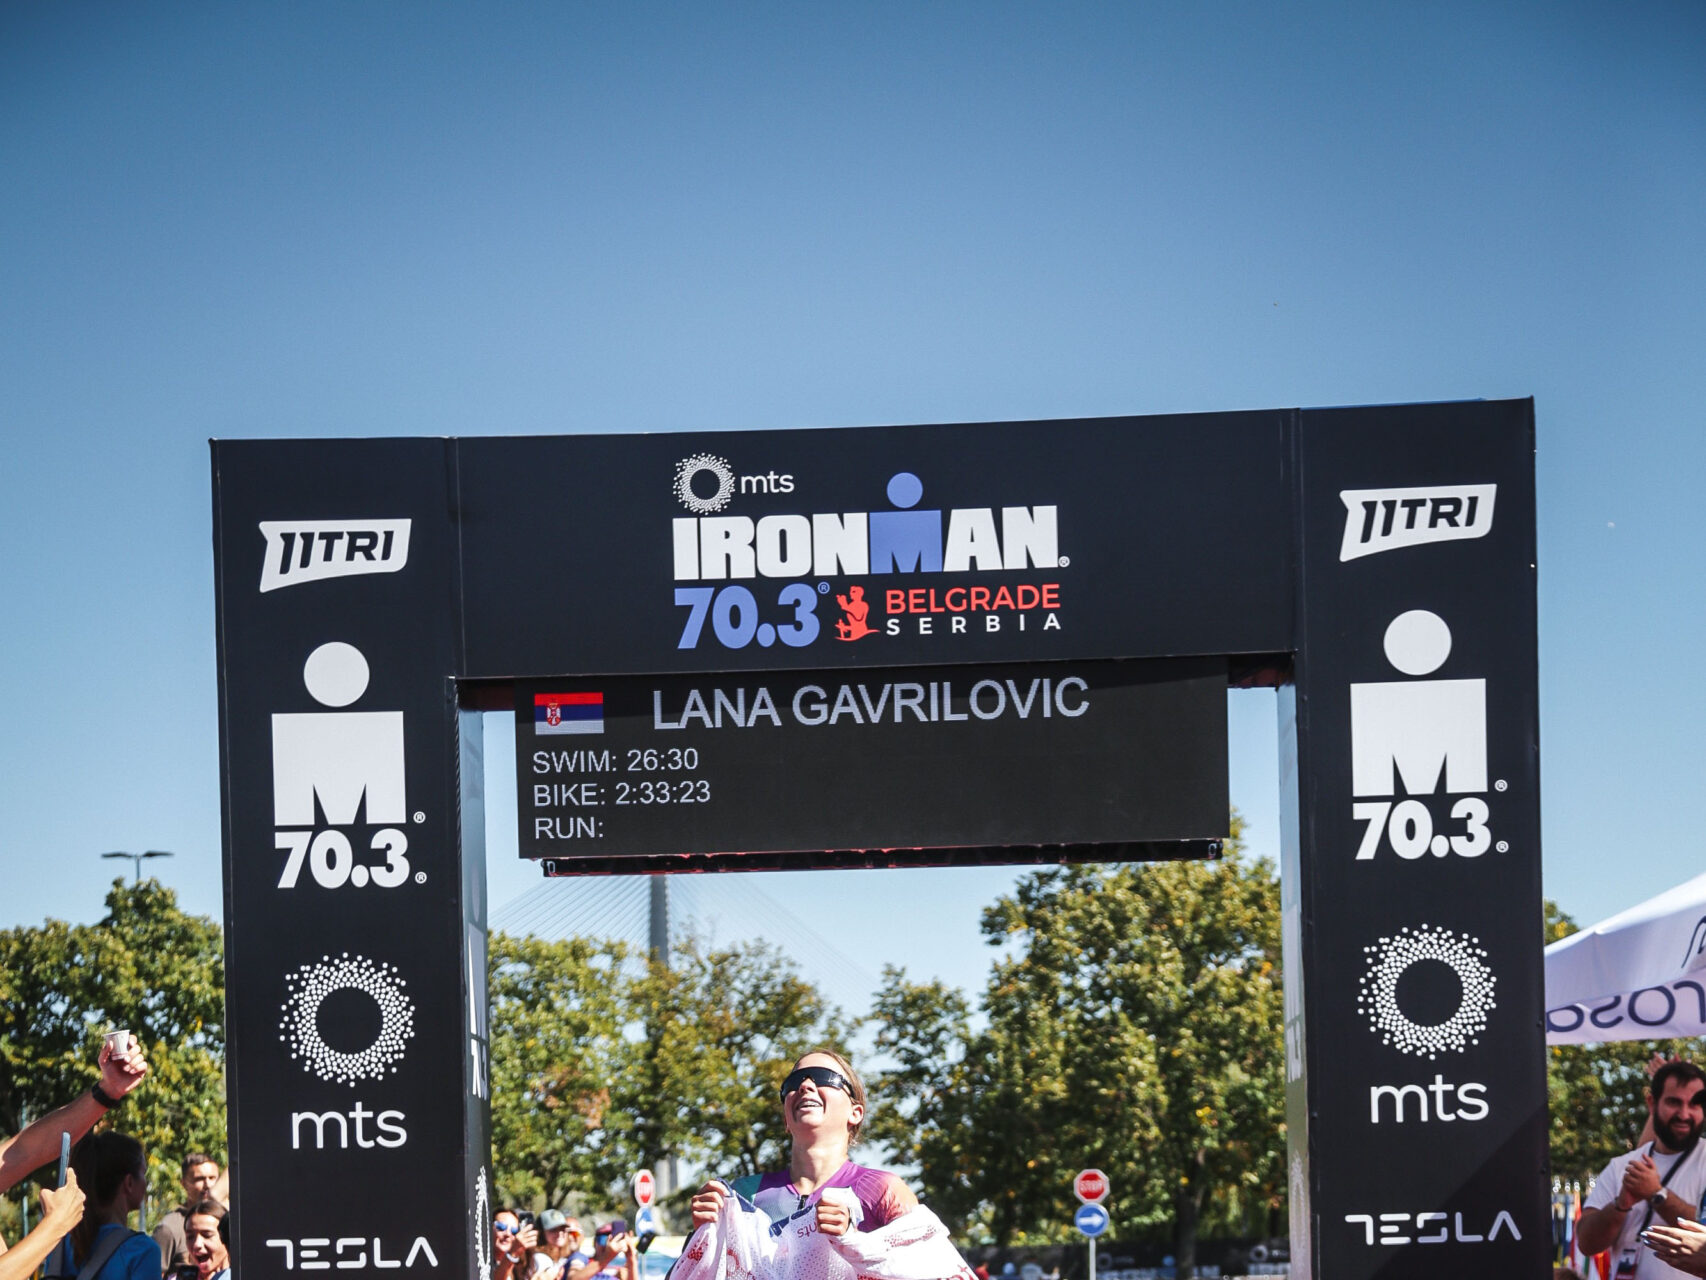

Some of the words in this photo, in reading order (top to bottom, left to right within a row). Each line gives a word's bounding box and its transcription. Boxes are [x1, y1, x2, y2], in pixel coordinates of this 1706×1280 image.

[740, 470, 795, 495] mts
[672, 505, 1059, 580] IRONMAN
[674, 583, 820, 649] 70.3
[885, 584, 1061, 614] BELGRADE
[886, 613, 1061, 636] SERBIA
[652, 687, 782, 731] LANA
[791, 676, 1090, 726] GAVRILOVIC
[533, 750, 618, 774] SWIM:
[626, 747, 699, 772] 26:30
[533, 783, 606, 808] BIKE:
[614, 780, 711, 806] 2:33:23
[534, 817, 604, 841] RUN:
[1352, 797, 1492, 860] 70.3
[274, 828, 410, 889] 70.3
[1370, 1074, 1490, 1123] mts
[292, 1101, 408, 1149] mts
[1345, 1210, 1522, 1246] TESLA
[266, 1236, 438, 1270] TESLA
